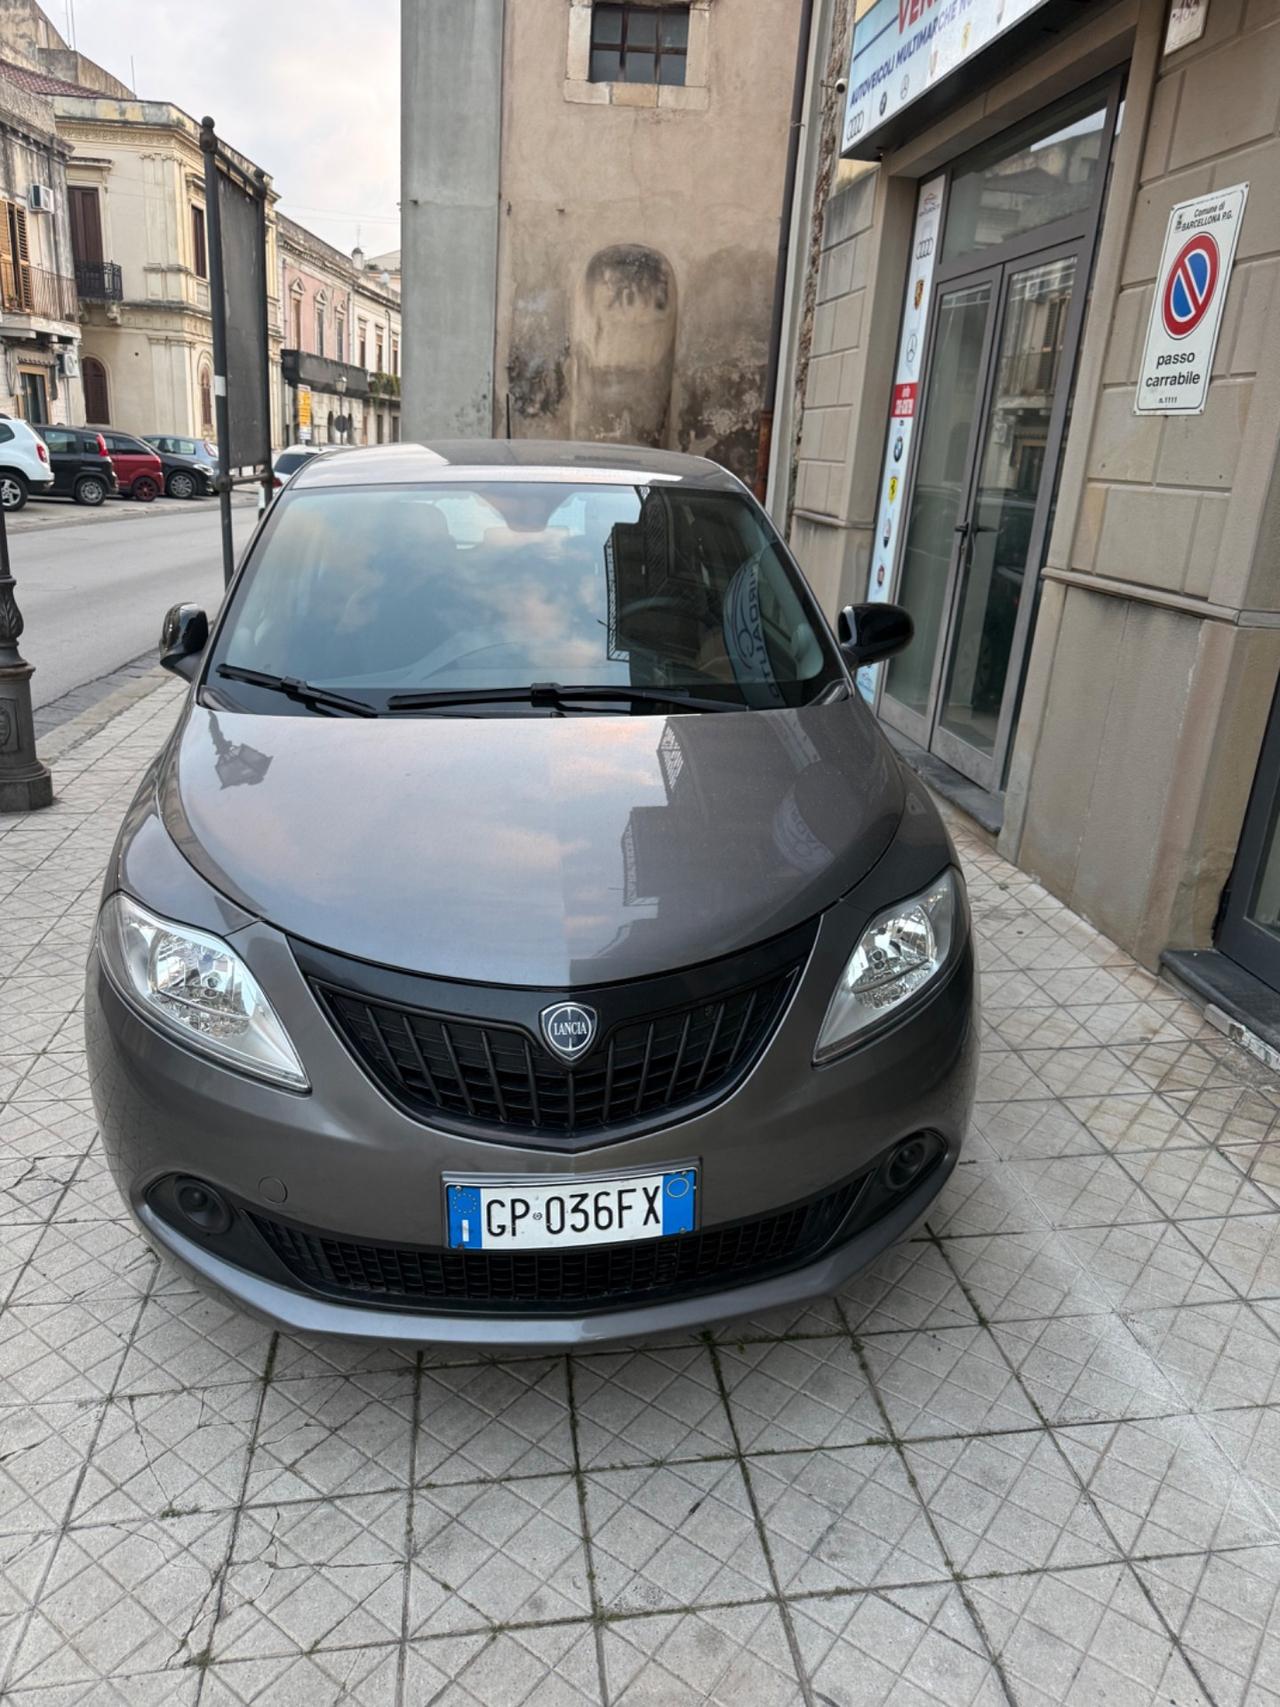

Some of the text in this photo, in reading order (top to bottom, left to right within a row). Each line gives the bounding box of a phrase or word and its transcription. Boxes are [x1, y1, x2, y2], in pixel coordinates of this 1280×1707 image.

[898, 0, 937, 34] VEN
[850, 0, 958, 108] AUTOVEICOLI MULTIMARCHE
[1194, 201, 1226, 218] Comune di
[1181, 210, 1233, 231] BARCELLONA P.G.
[1156, 352, 1195, 369] passo
[1145, 370, 1201, 388] carrabile
[553, 1021, 587, 1036] LANCIA
